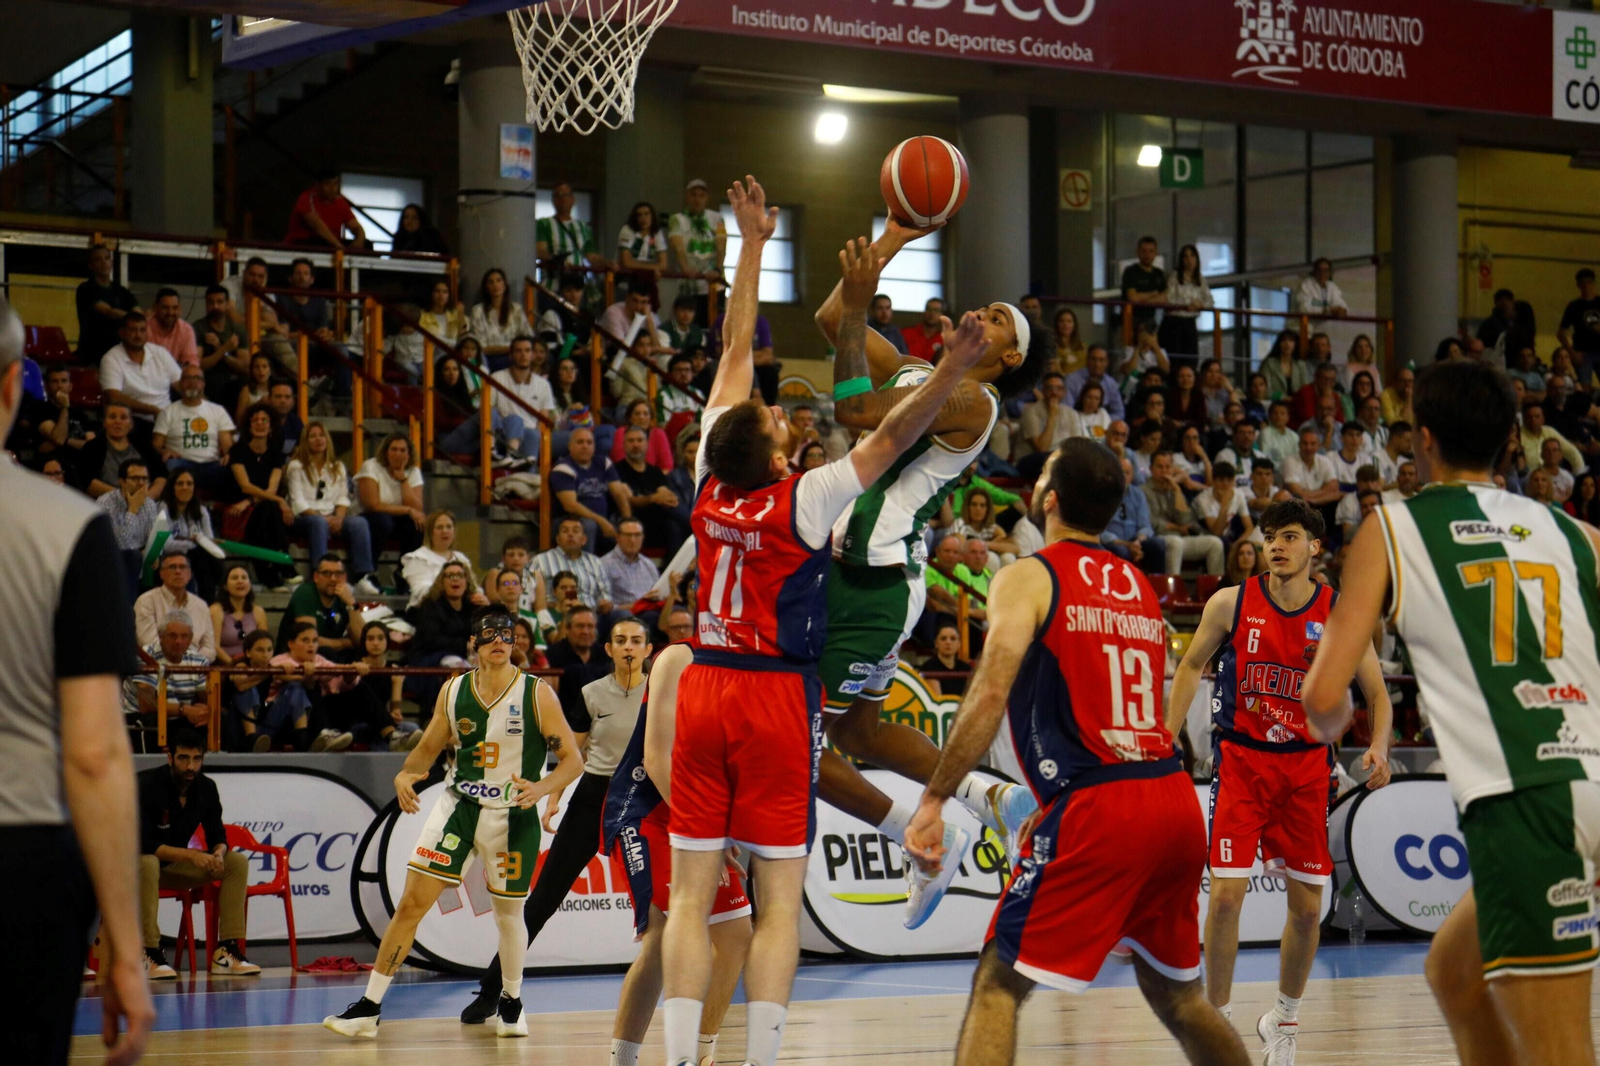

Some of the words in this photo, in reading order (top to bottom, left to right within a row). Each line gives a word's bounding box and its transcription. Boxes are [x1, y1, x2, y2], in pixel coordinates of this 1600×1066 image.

[732, 5, 809, 32] Instituto
[813, 14, 903, 45] Municipal
[907, 26, 931, 45] de
[935, 27, 1016, 54] Deportes
[1020, 36, 1094, 62] Córdoba
[1302, 6, 1424, 46] AYUNTAMIENTO
[1302, 41, 1324, 70] DE
[1327, 41, 1406, 78] CÓRDOBA
[1565, 75, 1600, 111] CÓ
[1173, 155, 1191, 181] D
[183, 433, 209, 449] CCB
[709, 545, 743, 618] 11
[1246, 616, 1266, 625] vive
[1456, 557, 1563, 666] 77
[1247, 628, 1260, 654] 6
[1102, 643, 1157, 731] 13
[1240, 663, 1307, 701] JAENC
[472, 741, 500, 769] 33
[233, 832, 358, 872] ACC
[496, 852, 523, 880] 33
[1220, 838, 1232, 863] 6
[1303, 861, 1323, 870] vive
[1394, 834, 1470, 881] CO
[615, 897, 632, 910] ELE
[730, 895, 745, 905] vive
